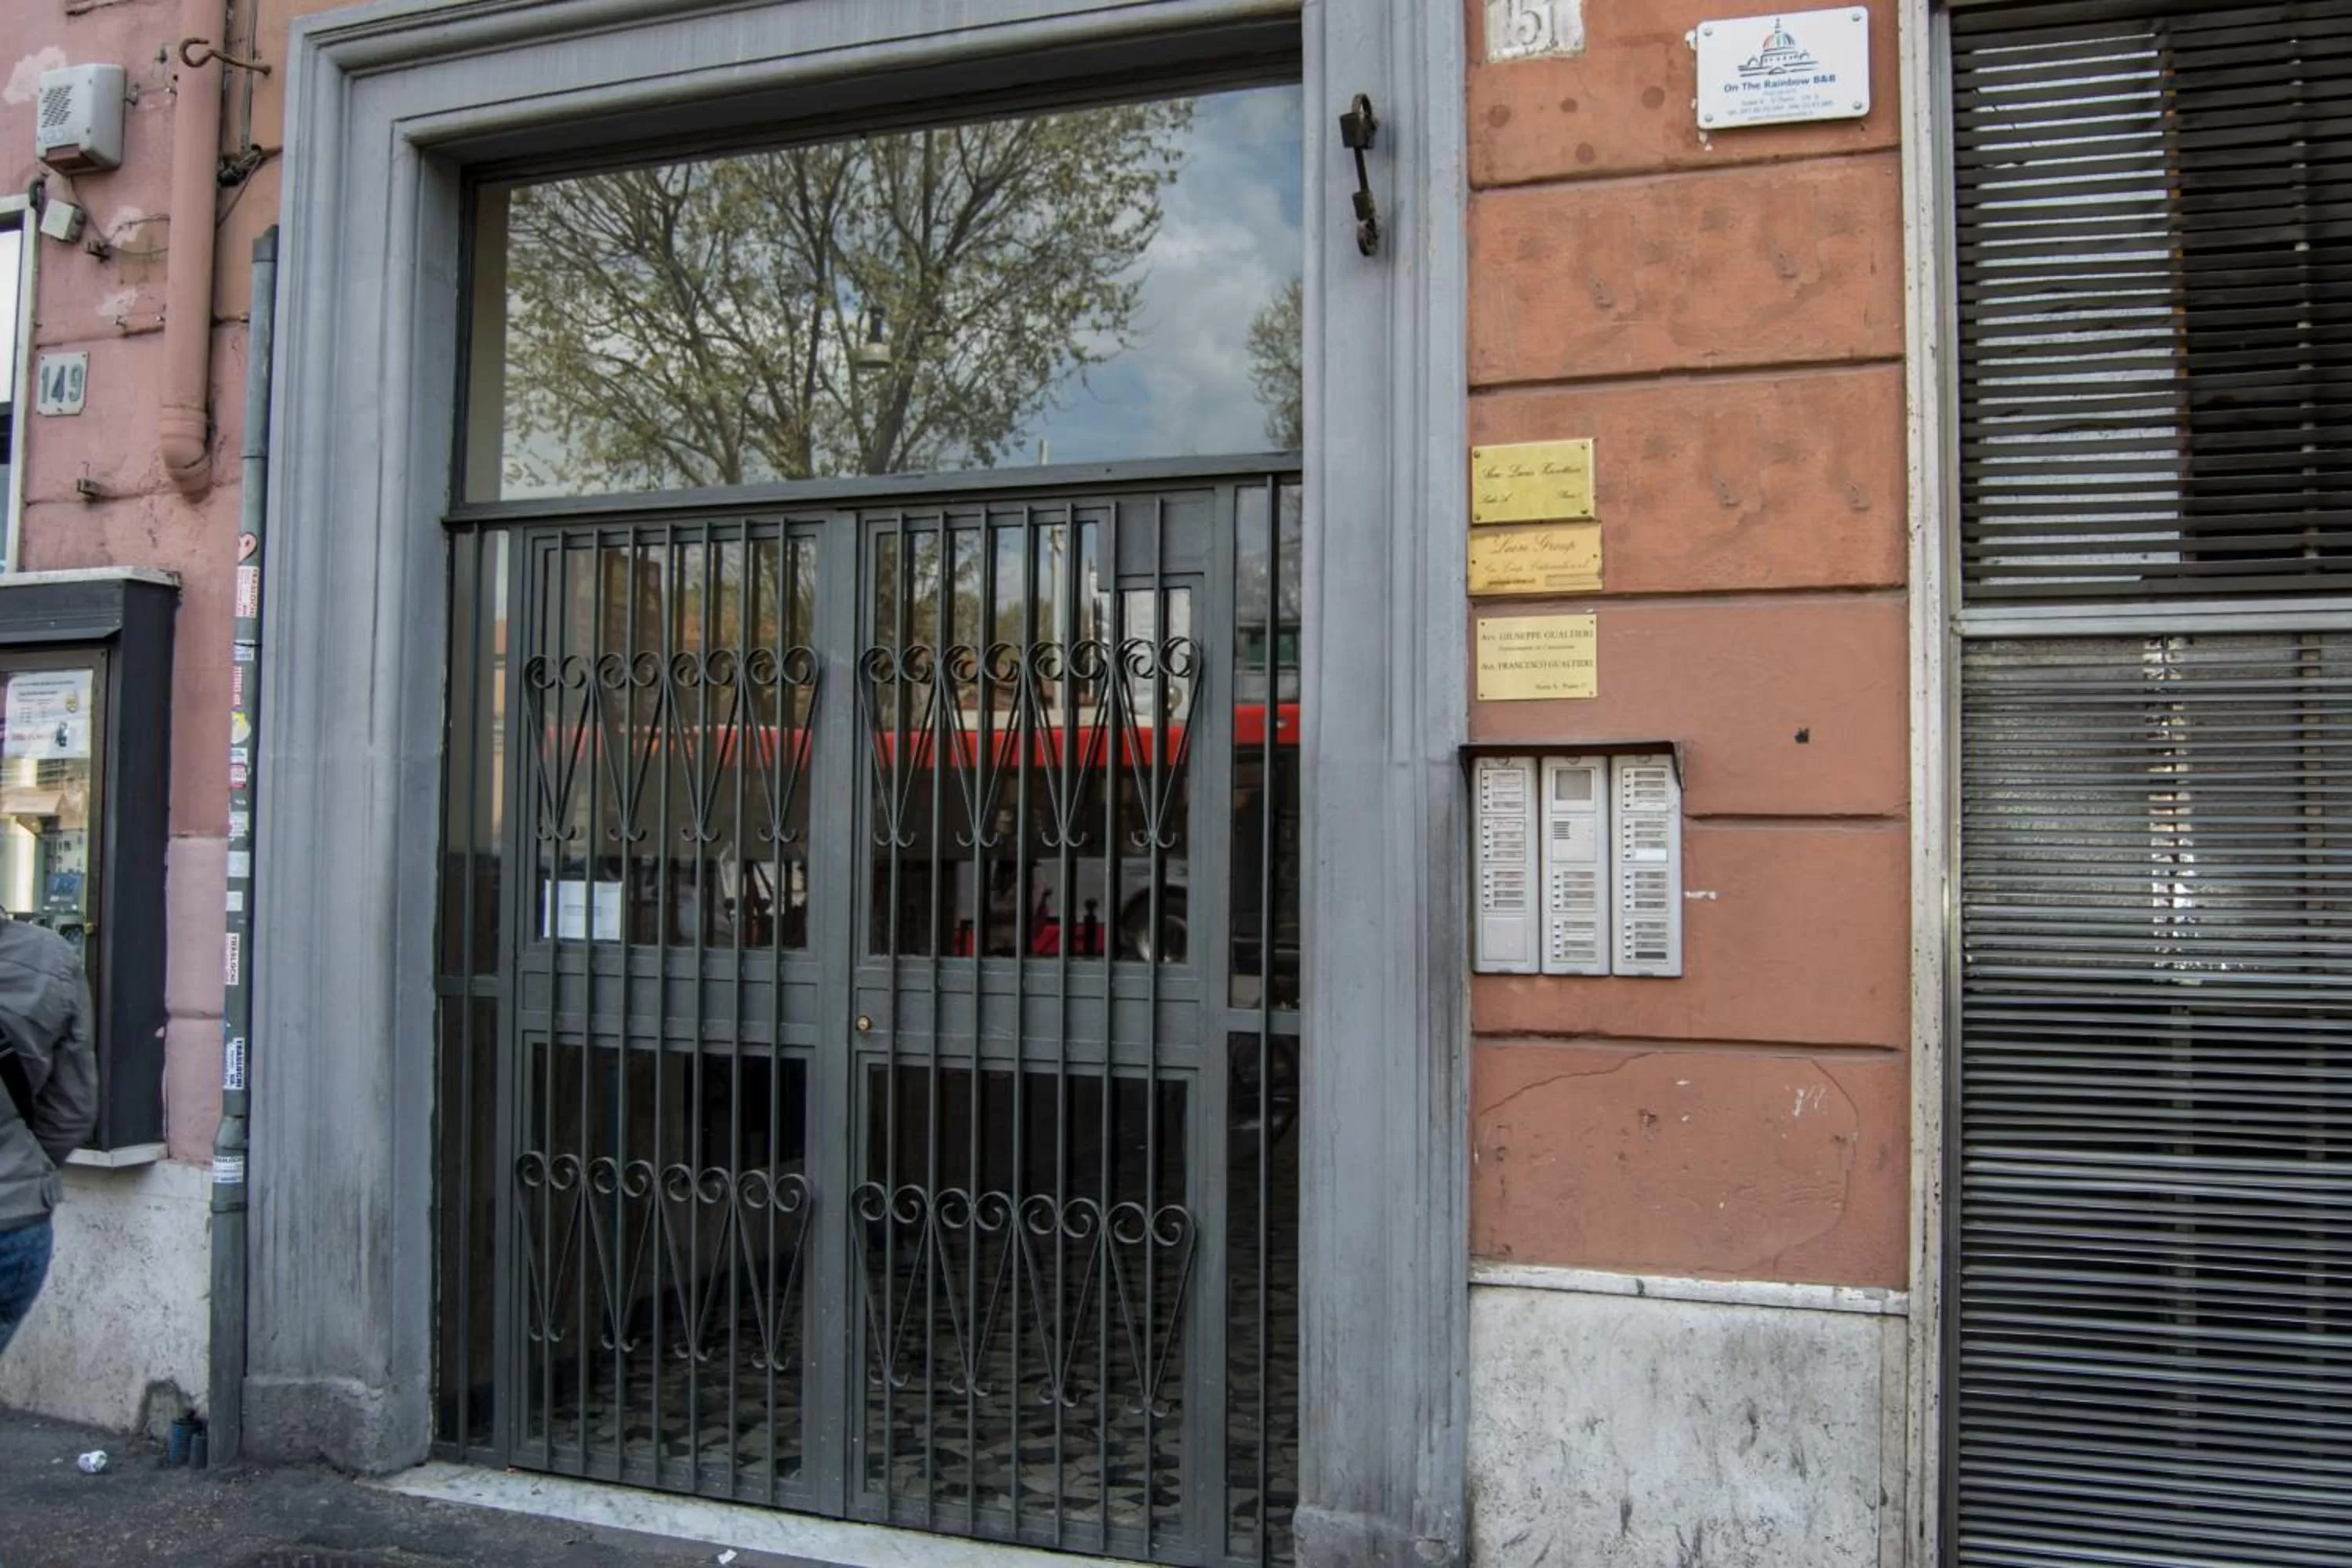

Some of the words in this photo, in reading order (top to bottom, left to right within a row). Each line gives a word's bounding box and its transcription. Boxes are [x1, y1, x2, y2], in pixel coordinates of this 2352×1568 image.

[1724, 83, 1738, 93] On
[1743, 81, 1760, 91] The
[1764, 76, 1809, 89] Rainbow
[1813, 74, 1836, 84] B&B
[41, 364, 84, 404] 149
